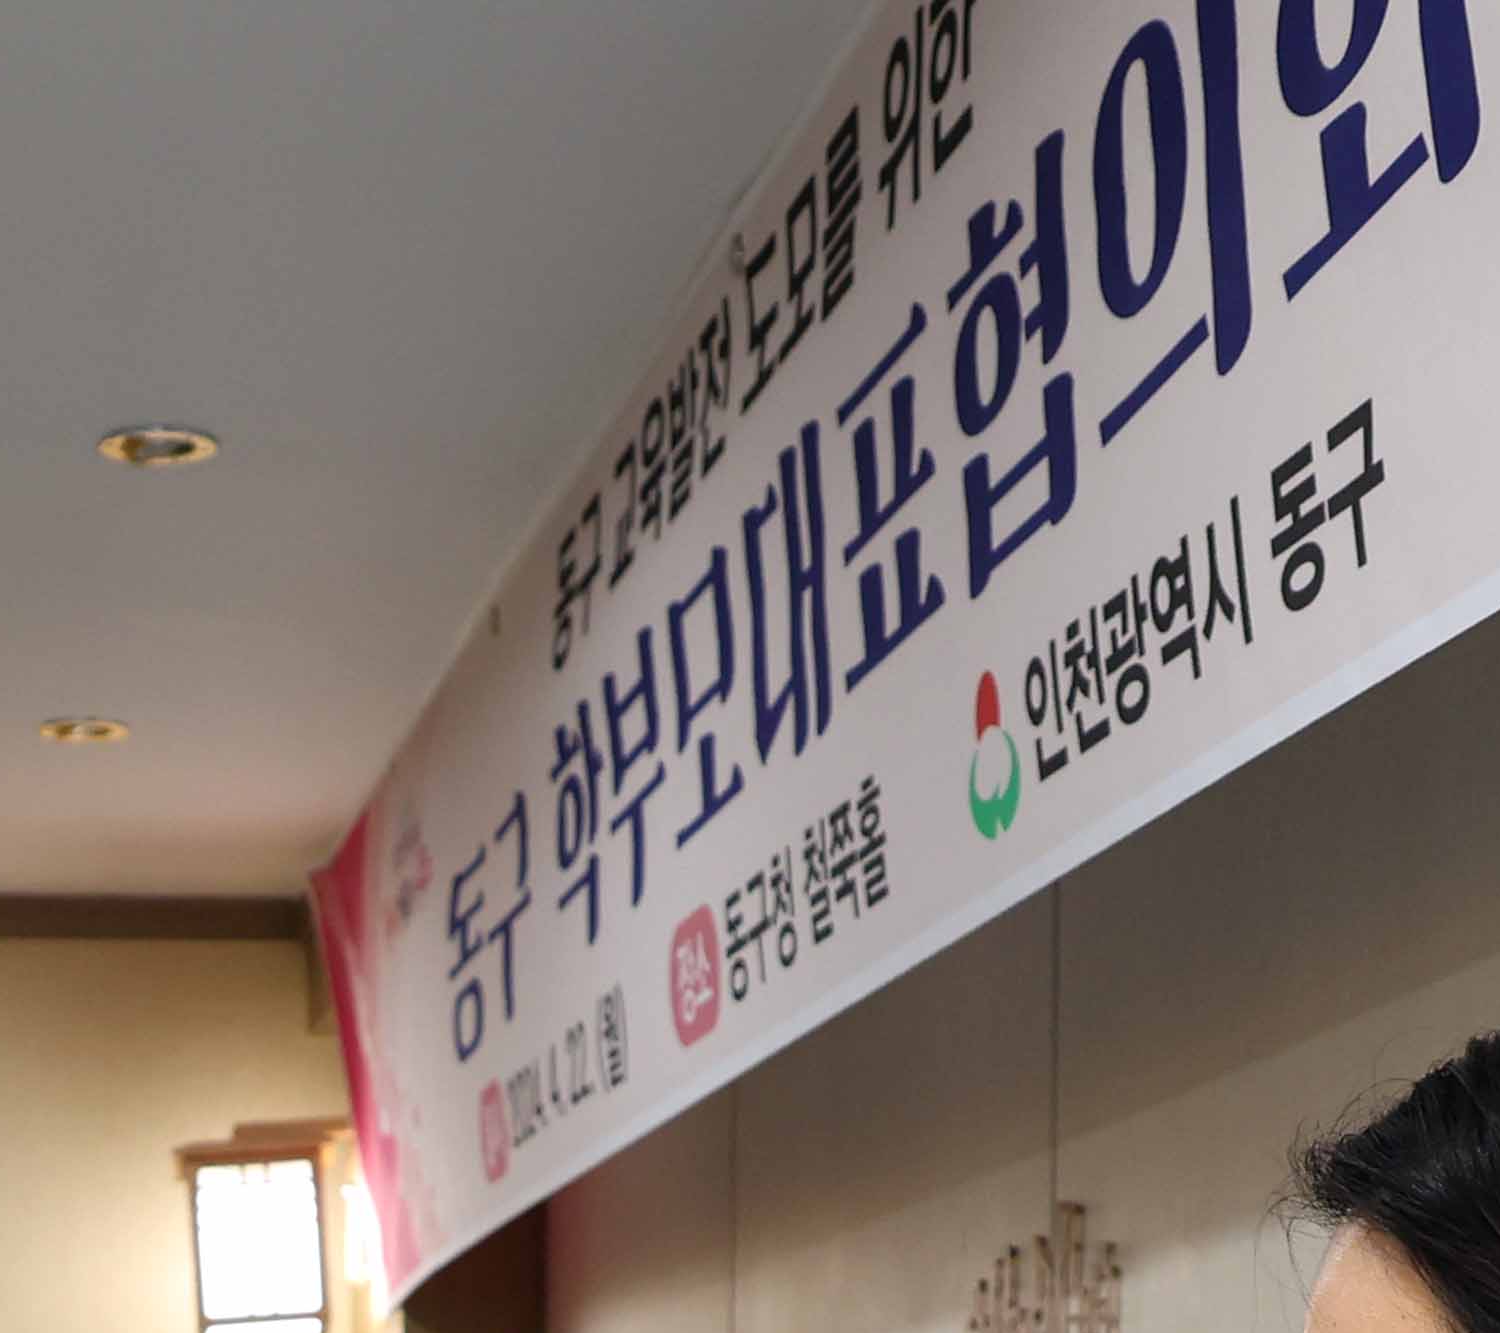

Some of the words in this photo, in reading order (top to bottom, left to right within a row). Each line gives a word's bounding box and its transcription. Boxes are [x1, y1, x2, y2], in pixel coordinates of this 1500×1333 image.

[551, 491, 602, 672] 동구
[609, 295, 732, 591] 교육발전
[740, 104, 863, 416] 도모를
[879, 0, 976, 232] 위한
[1024, 495, 1254, 782] 인천광역시
[1270, 397, 1385, 613] 동구
[448, 789, 532, 1064] 동구
[725, 845, 798, 1002] 동구청
[803, 775, 889, 945] 철쭉홀
